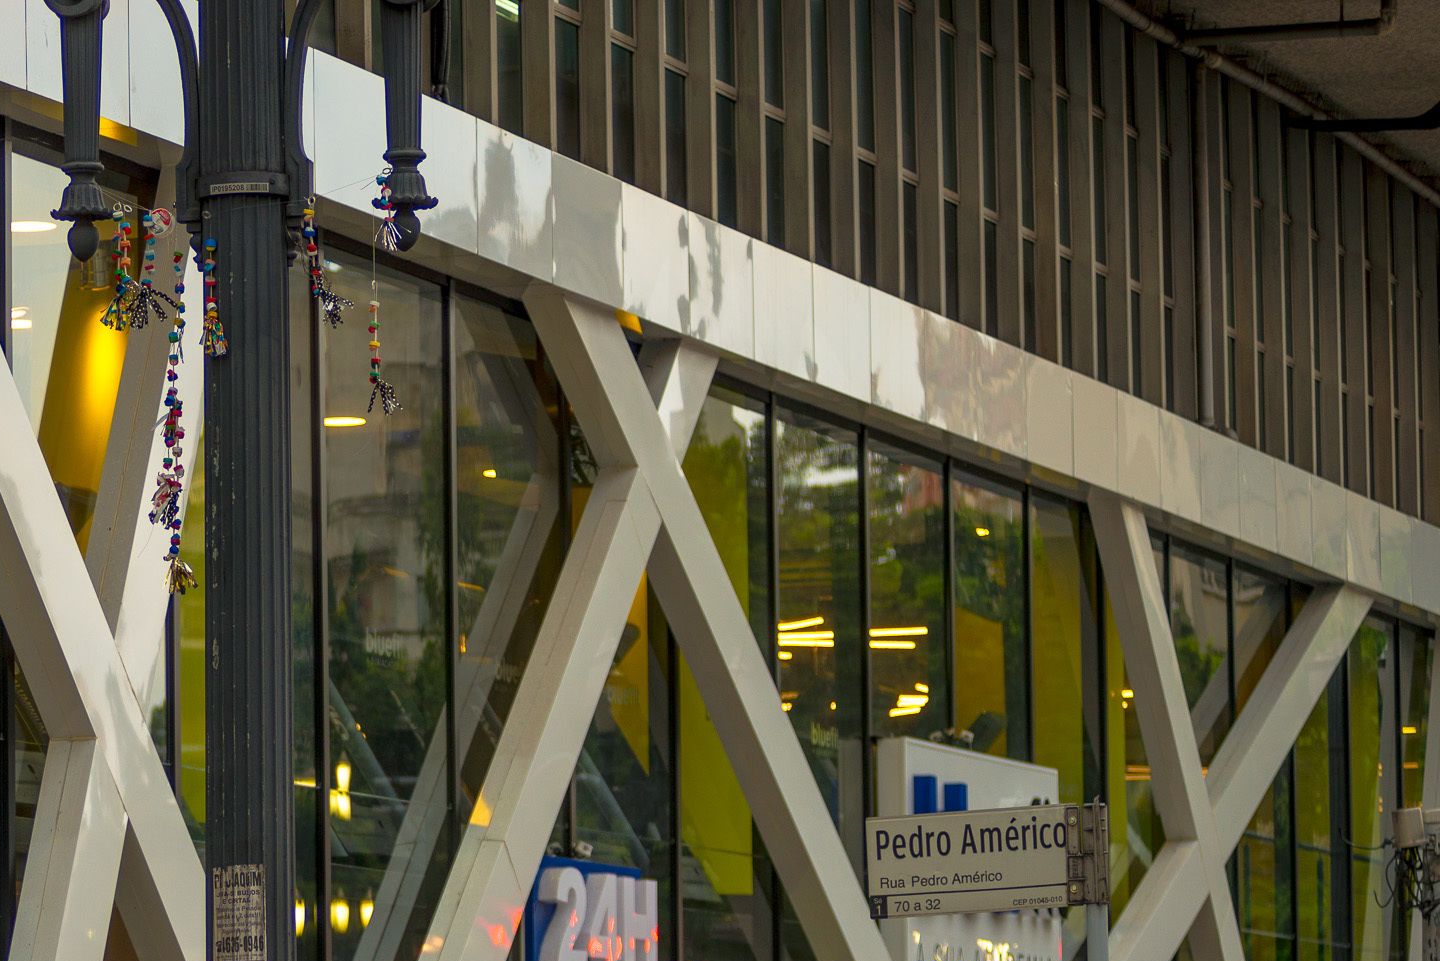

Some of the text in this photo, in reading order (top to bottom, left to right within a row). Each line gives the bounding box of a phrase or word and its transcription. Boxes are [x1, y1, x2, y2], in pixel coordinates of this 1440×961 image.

[876, 816, 1066, 861] Pedro Américo
[880, 870, 1003, 889] Rua Pedro Américo
[894, 899, 941, 912] 70 a 32
[1012, 898, 1027, 906] CEP
